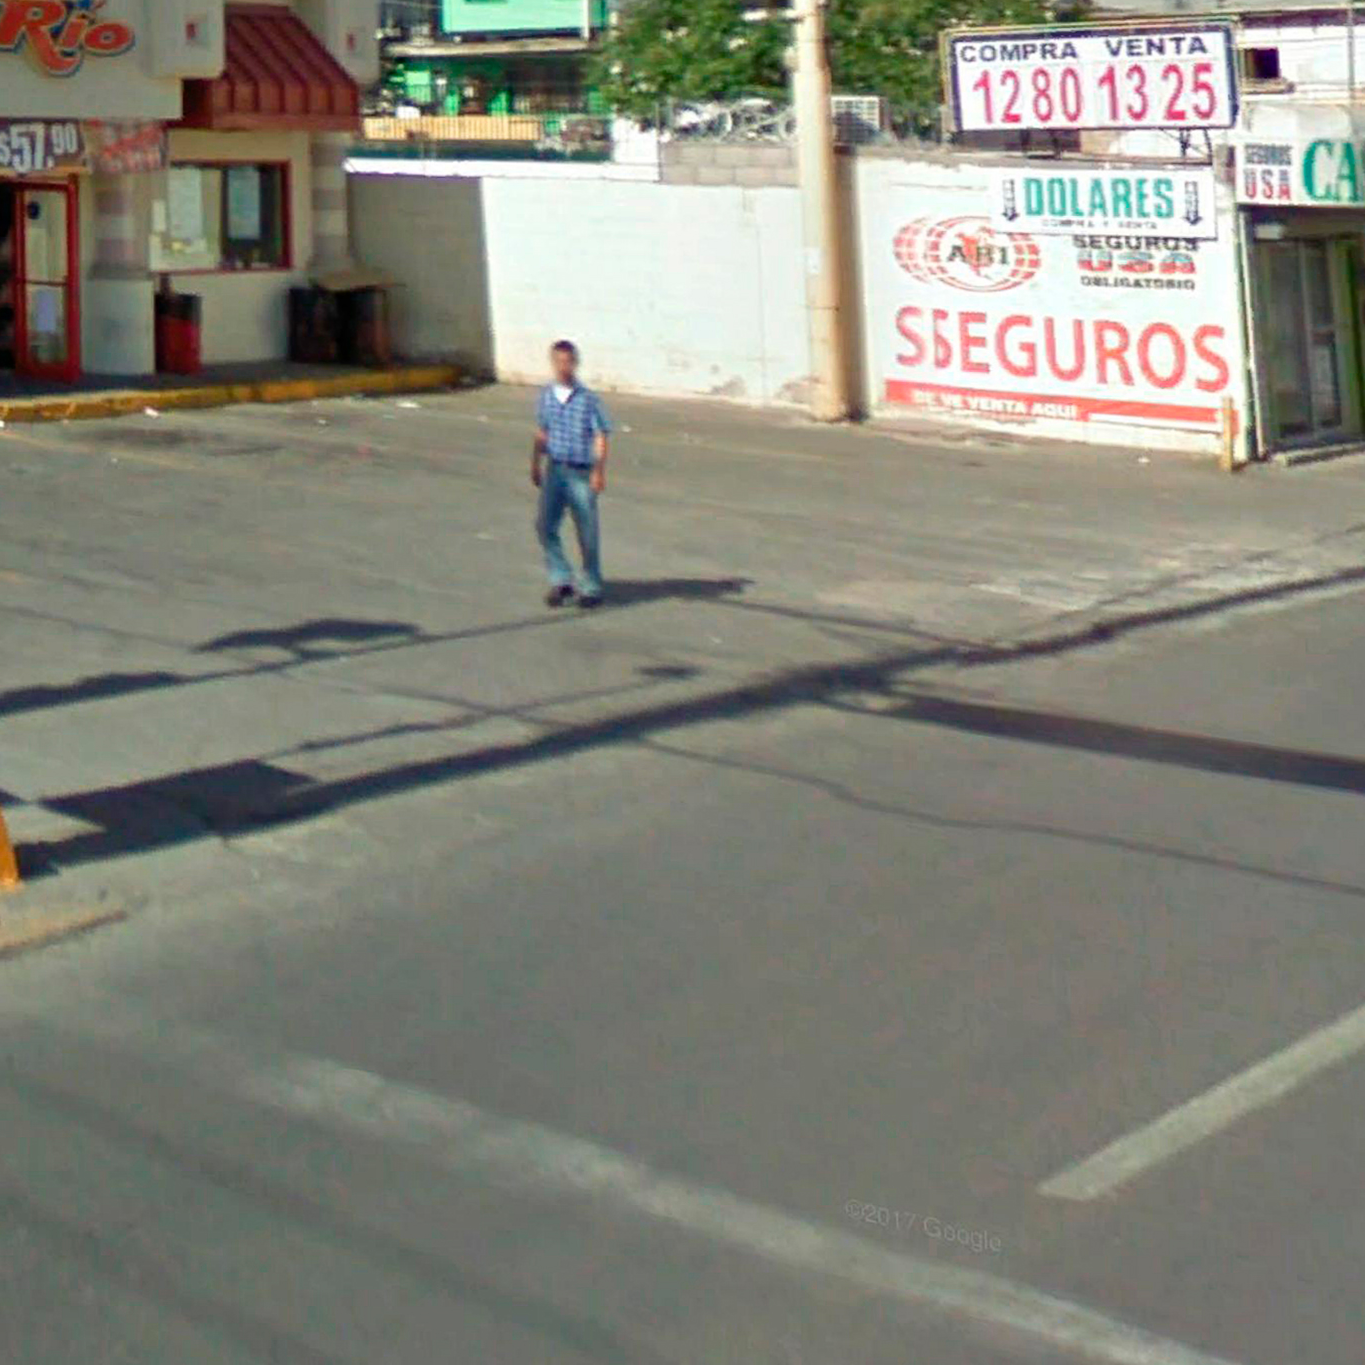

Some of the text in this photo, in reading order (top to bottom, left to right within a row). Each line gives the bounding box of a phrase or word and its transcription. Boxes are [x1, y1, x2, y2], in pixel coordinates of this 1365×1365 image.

[959, 36, 1208, 63] COMPRA VENTA
[1023, 176, 1175, 219] DOLARES
[1243, 168, 1291, 200] USA
[1072, 234, 1199, 252] SEGUROS
